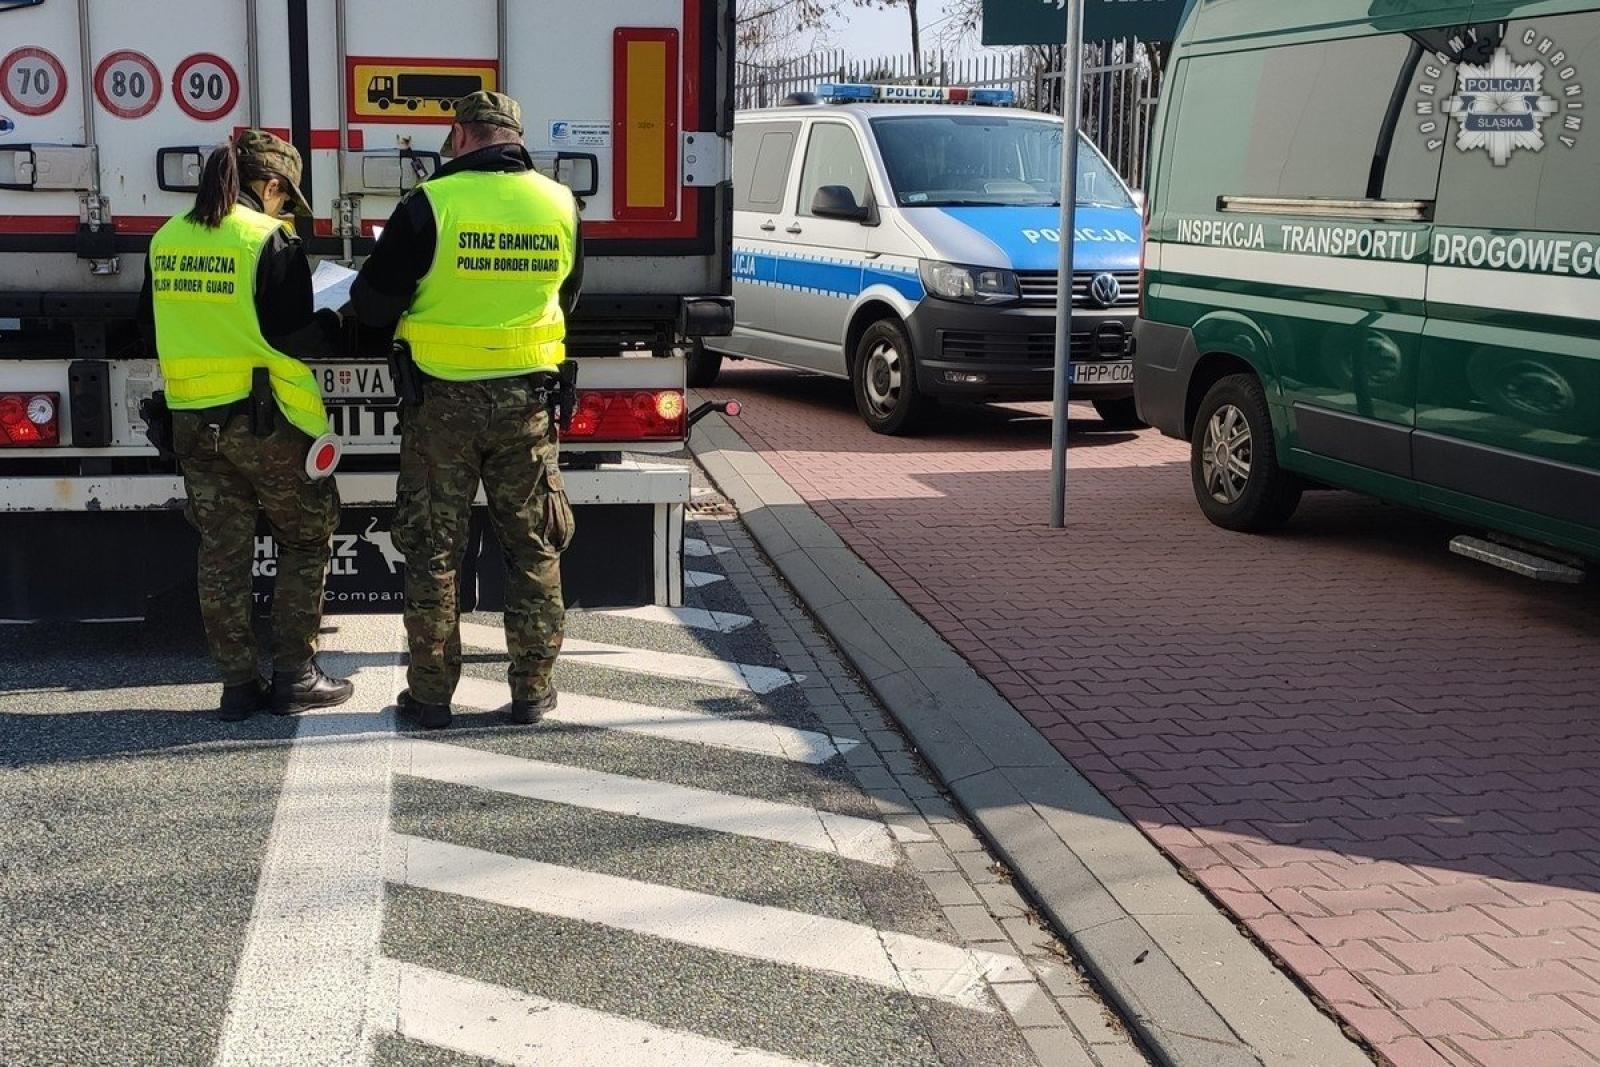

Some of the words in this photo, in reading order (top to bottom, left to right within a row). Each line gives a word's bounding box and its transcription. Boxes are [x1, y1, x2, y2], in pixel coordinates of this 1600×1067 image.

[16, 68, 50, 95] 70
[112, 70, 145, 98] 80
[189, 72, 223, 100] 90
[886, 87, 944, 98] POLICJA
[499, 233, 560, 251] GRANICZNA
[1021, 228, 1137, 245] POICJA
[1177, 219, 1265, 249] INSPEKCJA
[1281, 225, 1417, 260] TRANSPORTU
[1433, 233, 1600, 275] DROGOWEG
[180, 255, 235, 274] GRANICZNA
[457, 256, 491, 271] POLISH
[494, 258, 529, 272] BORDER
[532, 258, 560, 272] GUARD
[174, 279, 203, 293] BORDER
[206, 280, 235, 294] GUARD
[1077, 366, 1108, 382] HPP
[323, 590, 404, 601] Compan
